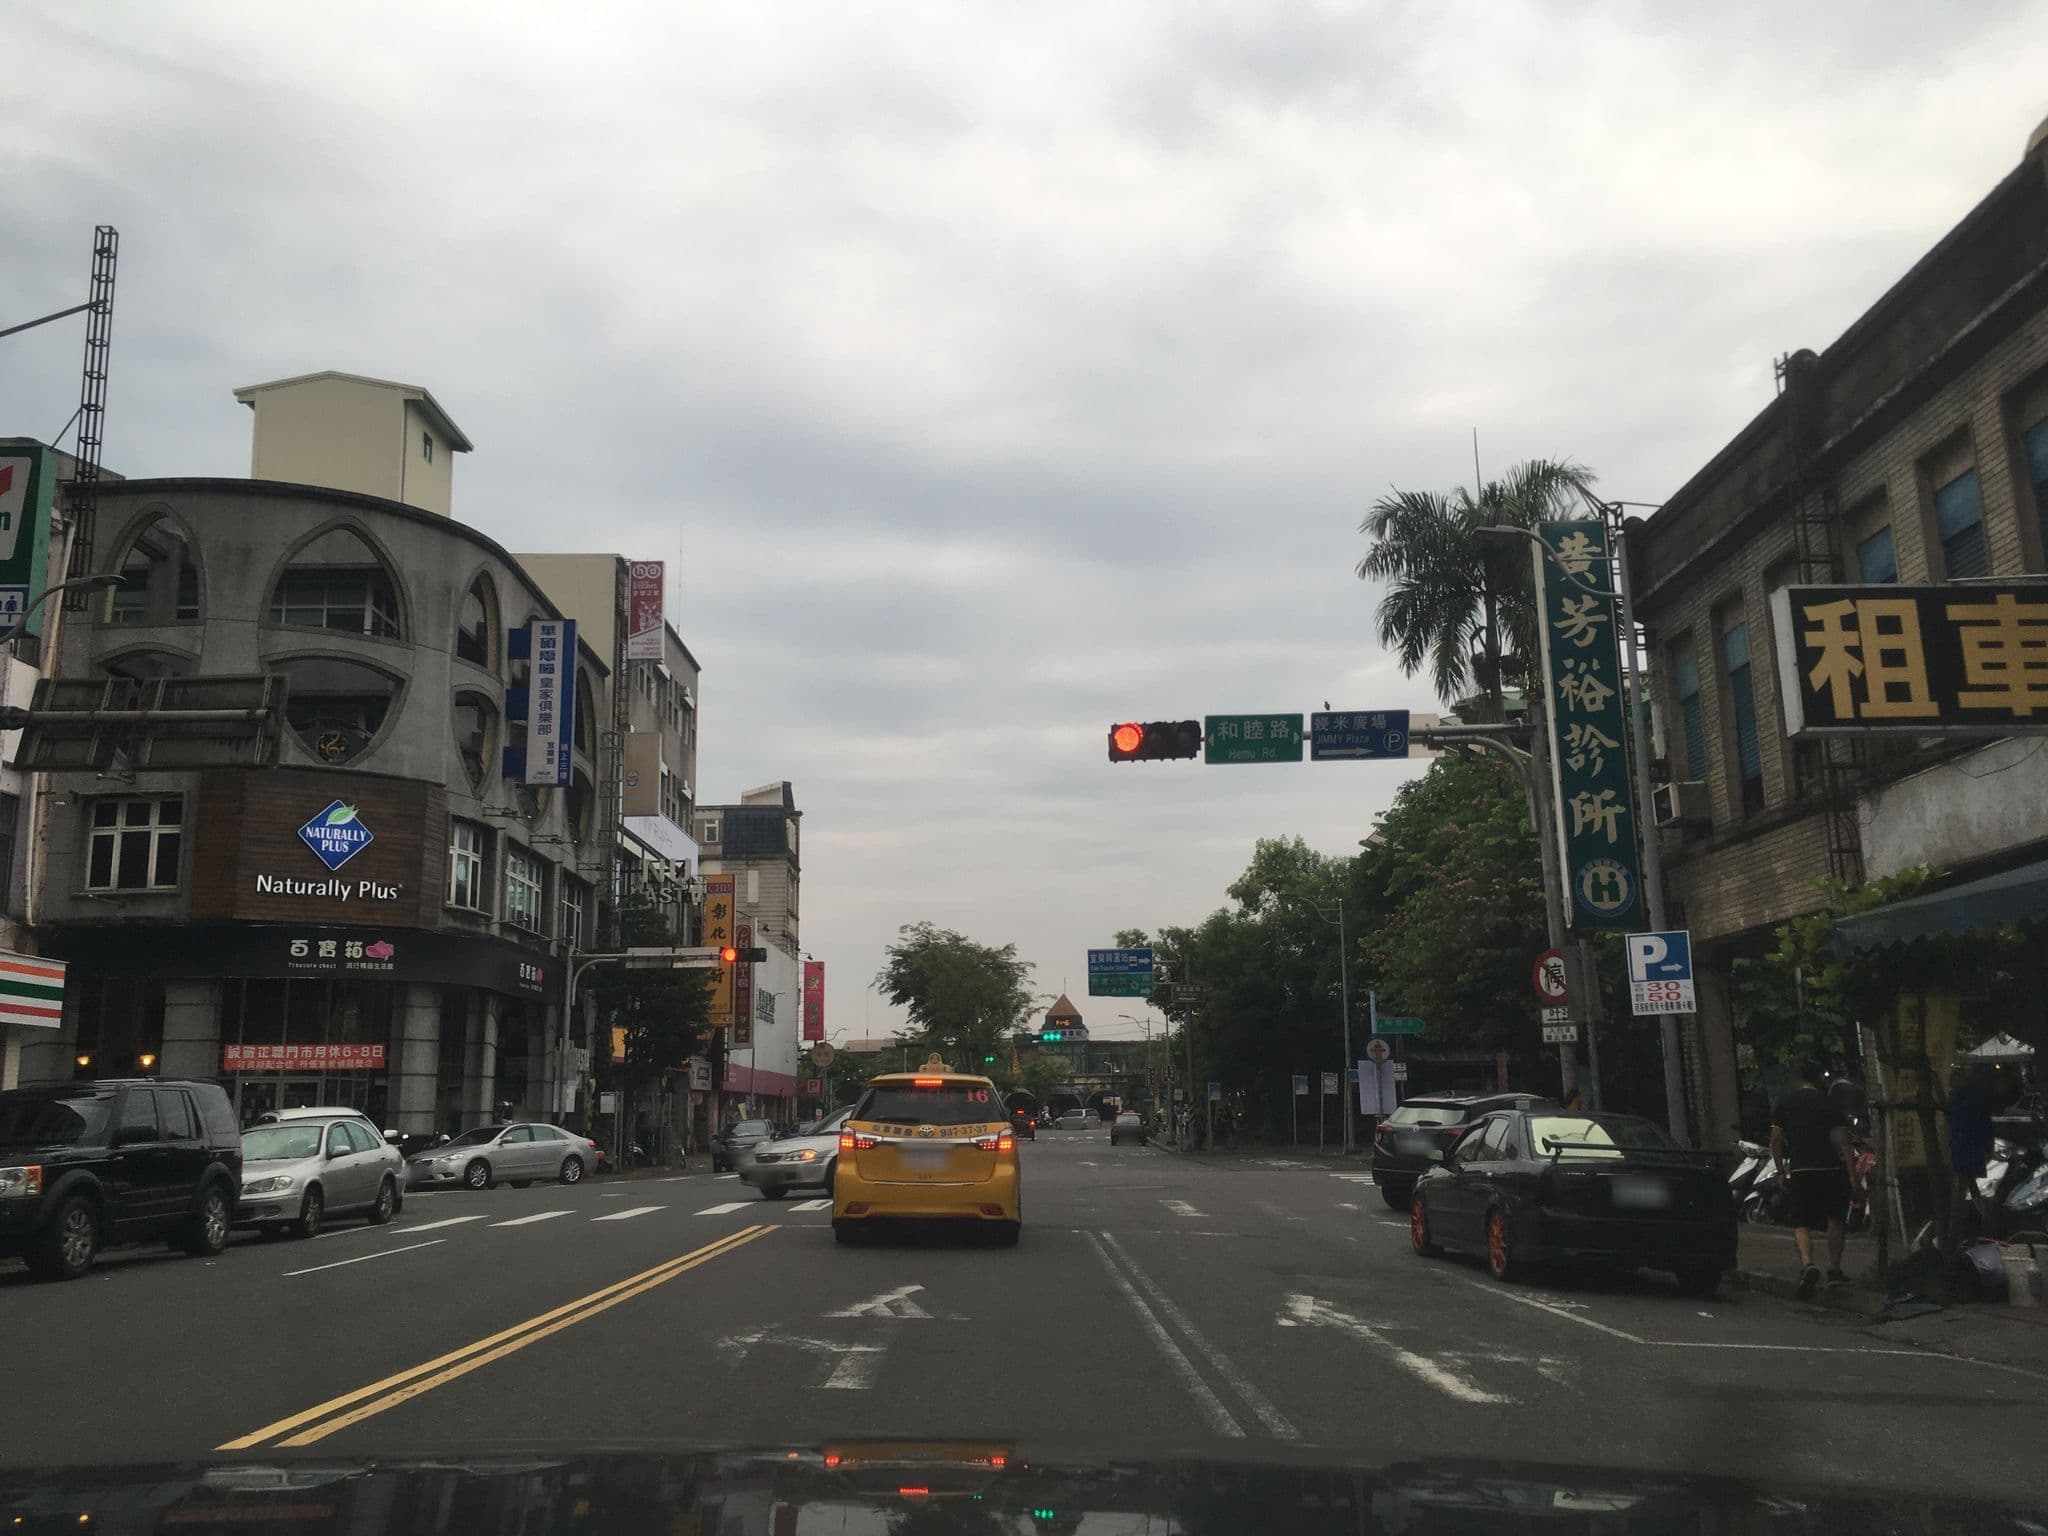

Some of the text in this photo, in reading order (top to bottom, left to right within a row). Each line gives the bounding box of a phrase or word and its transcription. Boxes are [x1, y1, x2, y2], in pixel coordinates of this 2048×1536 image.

[1803, 594, 2048, 719] 租車
[1548, 531, 1627, 843] 黃芳裕診所
[1218, 719, 1290, 740] 和睦路
[1316, 734, 1344, 745] JIMMY
[1228, 747, 1256, 760] Hemu
[305, 826, 367, 842] NATURALLY
[321, 839, 350, 853] PLUS
[256, 874, 398, 901] Naturally Plus
[710, 903, 727, 984] 彰化行
[1629, 935, 1668, 982] P
[1647, 981, 1681, 992] 30
[1648, 991, 1682, 1002] 50
[967, 1089, 989, 1104] 16
